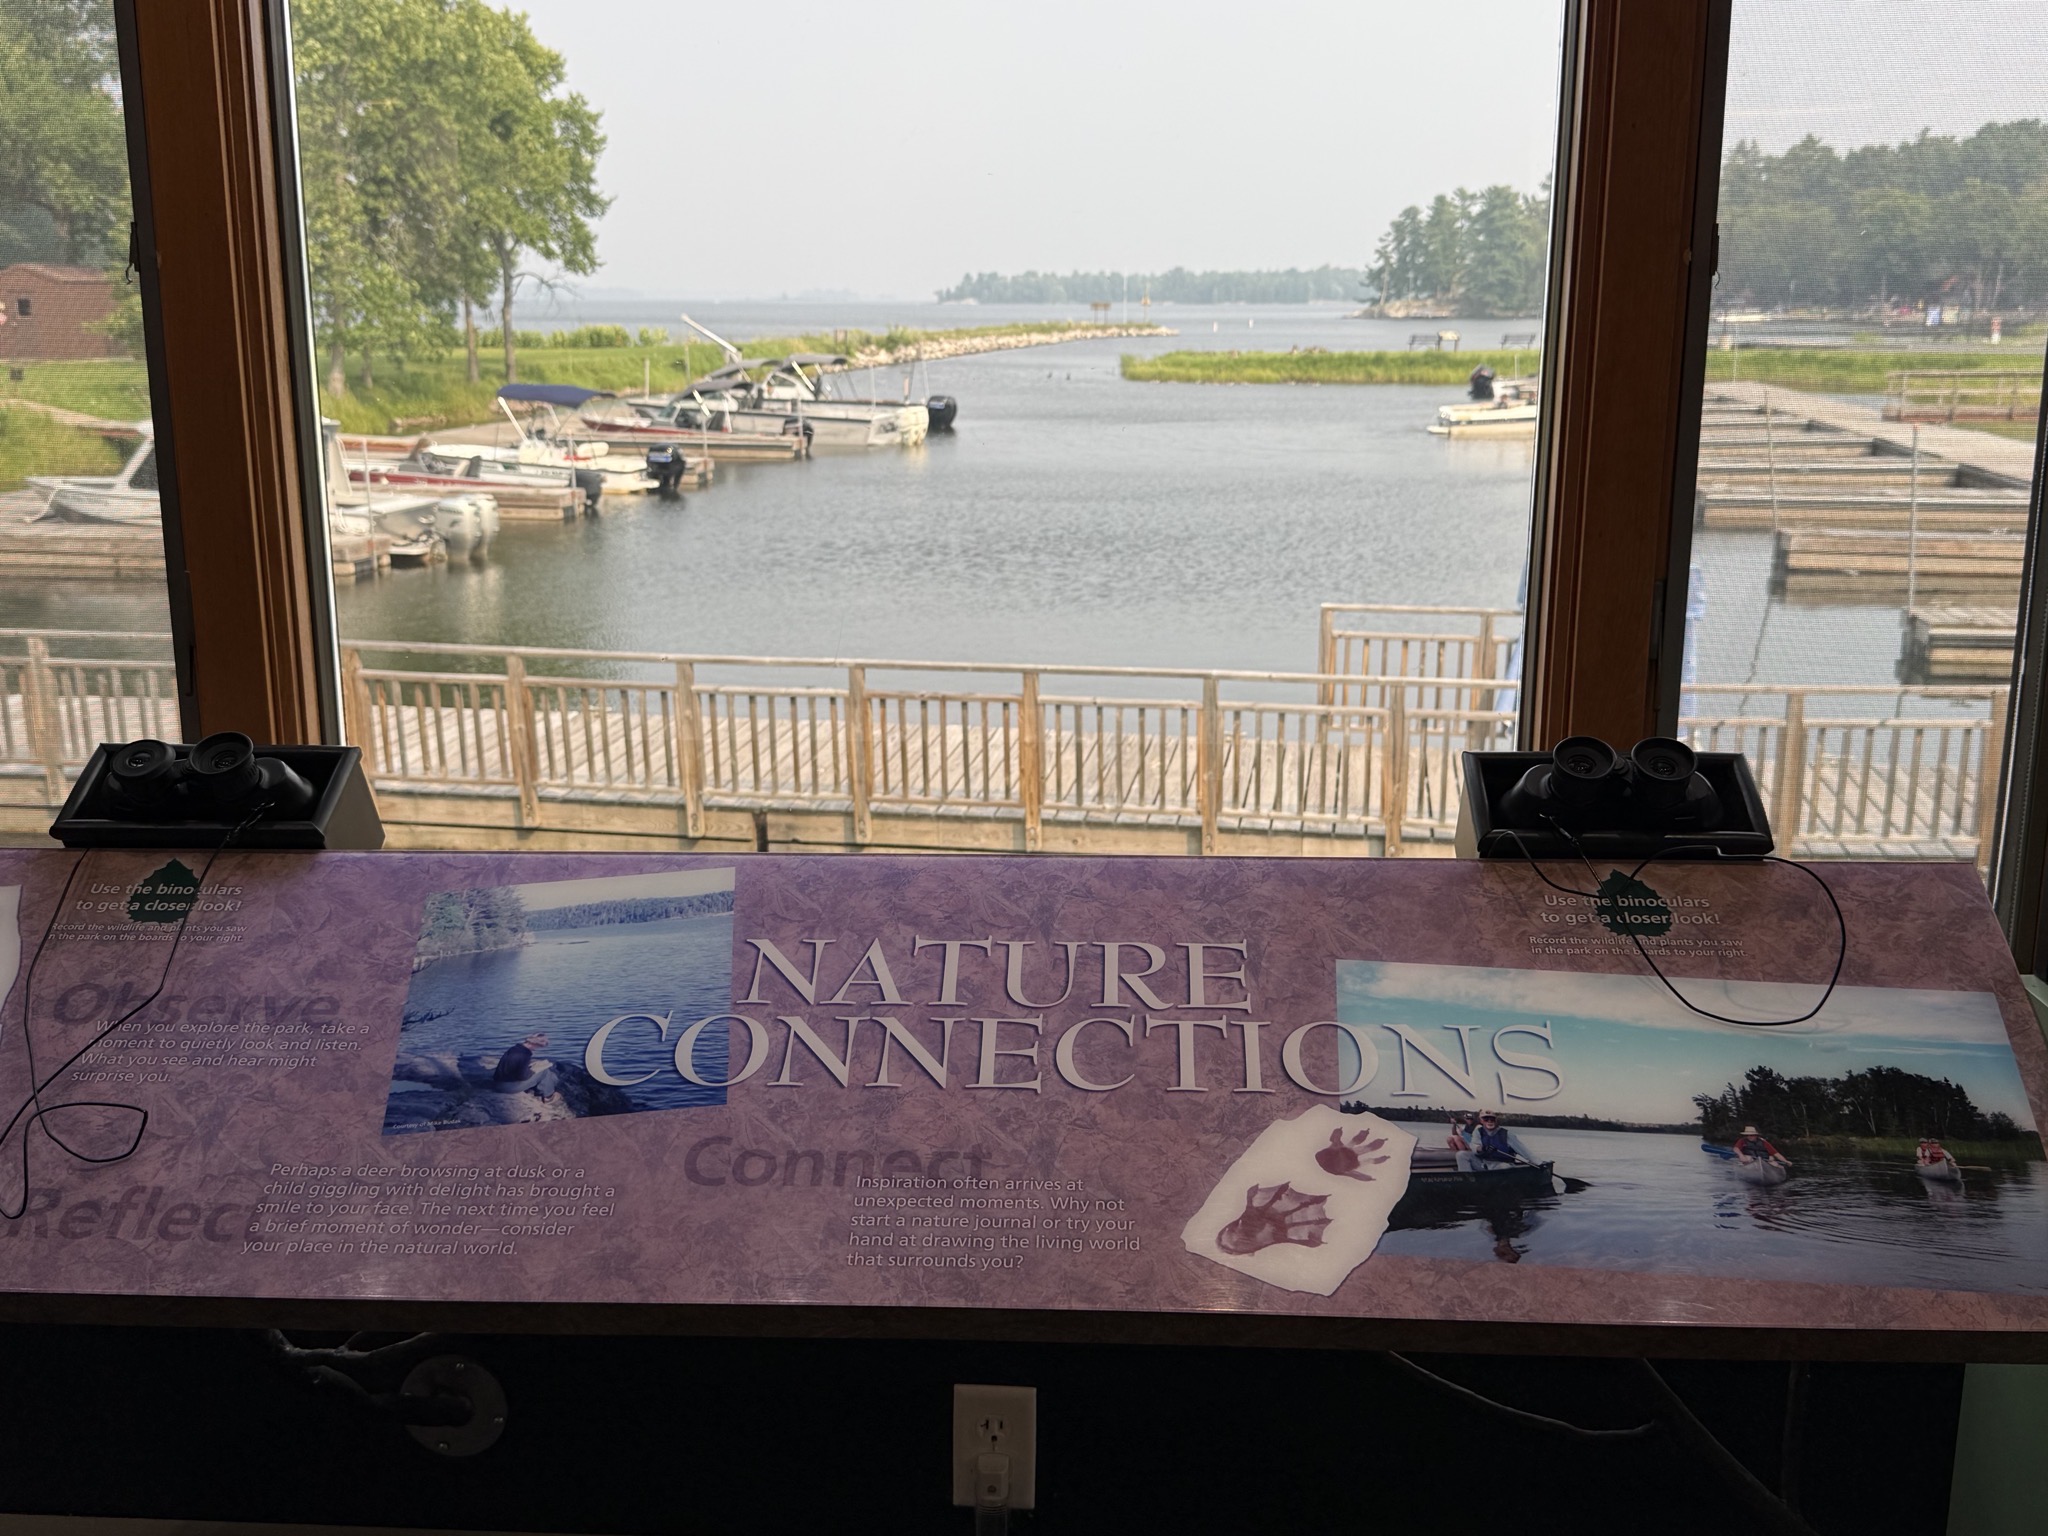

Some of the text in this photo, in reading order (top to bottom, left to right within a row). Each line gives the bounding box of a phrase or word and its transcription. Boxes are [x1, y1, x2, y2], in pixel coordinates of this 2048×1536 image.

[90, 883, 243, 896] Use the binoulars
[76, 900, 94, 911] to
[97, 900, 126, 913] get
[129, 902, 139, 911] a
[197, 900, 242, 912] look!
[1544, 894, 1710, 908] Use the binoculars
[1540, 912, 1560, 923] to
[1565, 912, 1595, 926] get
[1601, 914, 1611, 924] a
[1673, 912, 1721, 925] look!
[87, 923, 105, 931] the
[107, 923, 145, 932] wildlife
[147, 923, 168, 932] and
[168, 924, 201, 934] plnts
[203, 925, 223, 934] you
[58, 932, 75, 940] the
[77, 932, 101, 942] park
[119, 932, 136, 941] the
[138, 933, 174, 941] boards
[189, 935, 214, 943] your
[216, 933, 244, 943] right.
[1529, 936, 1567, 944] Record
[1570, 936, 1588, 945] the
[1591, 936, 1632, 945] wildlife
[1660, 938, 1693, 947] plants
[1696, 939, 1718, 948] you
[1531, 946, 1542, 954] in
[1545, 946, 1563, 954] the
[1566, 947, 1591, 956] park
[1612, 946, 1630, 955] the
[1632, 947, 1671, 956] bards
[1674, 948, 1686, 956] to
[1689, 949, 1714, 958] your
[1718, 949, 1748, 958] right.
[736, 935, 1252, 1011] NATURE
[53, 982, 340, 1028] Observe
[144, 1022, 176, 1035] you
[179, 1021, 239, 1035] explore
[244, 1022, 270, 1034] the
[273, 1022, 314, 1036] park,
[320, 1023, 356, 1034] take
[360, 1025, 370, 1034] a
[159, 1038, 176, 1049] to
[180, 1037, 237, 1052] quietly
[239, 1038, 275, 1050] look
[279, 1038, 312, 1050] and
[315, 1039, 362, 1051] listen.
[80, 1052, 318, 1070] What you see and hear might
[585, 1010, 1564, 1105] CONNECTIONS
[71, 1070, 171, 1084] surprise you.
[684, 1136, 992, 1187] Connect
[270, 1163, 585, 1181] Perhaps a deer browsing at dusk or a
[263, 1181, 615, 1200] child giggling with delight has brought a
[856, 1175, 1084, 1191] Inspiration often arrives at
[255, 1200, 615, 1220] smile to your face. The next time you feel
[854, 1195, 1125, 1213] unexpected moments. Why not
[6, 1186, 268, 1243] Reflect
[249, 1221, 260, 1232] a
[265, 1219, 309, 1233] brief
[310, 1222, 385, 1234] moment
[389, 1220, 410, 1234] of
[851, 1214, 1135, 1233] start a nature journal or try your
[241, 1239, 518, 1255] your place in the natural world.
[849, 1232, 1140, 1253] hand at drawing the living world
[846, 1252, 1024, 1271] that surrounds you?
